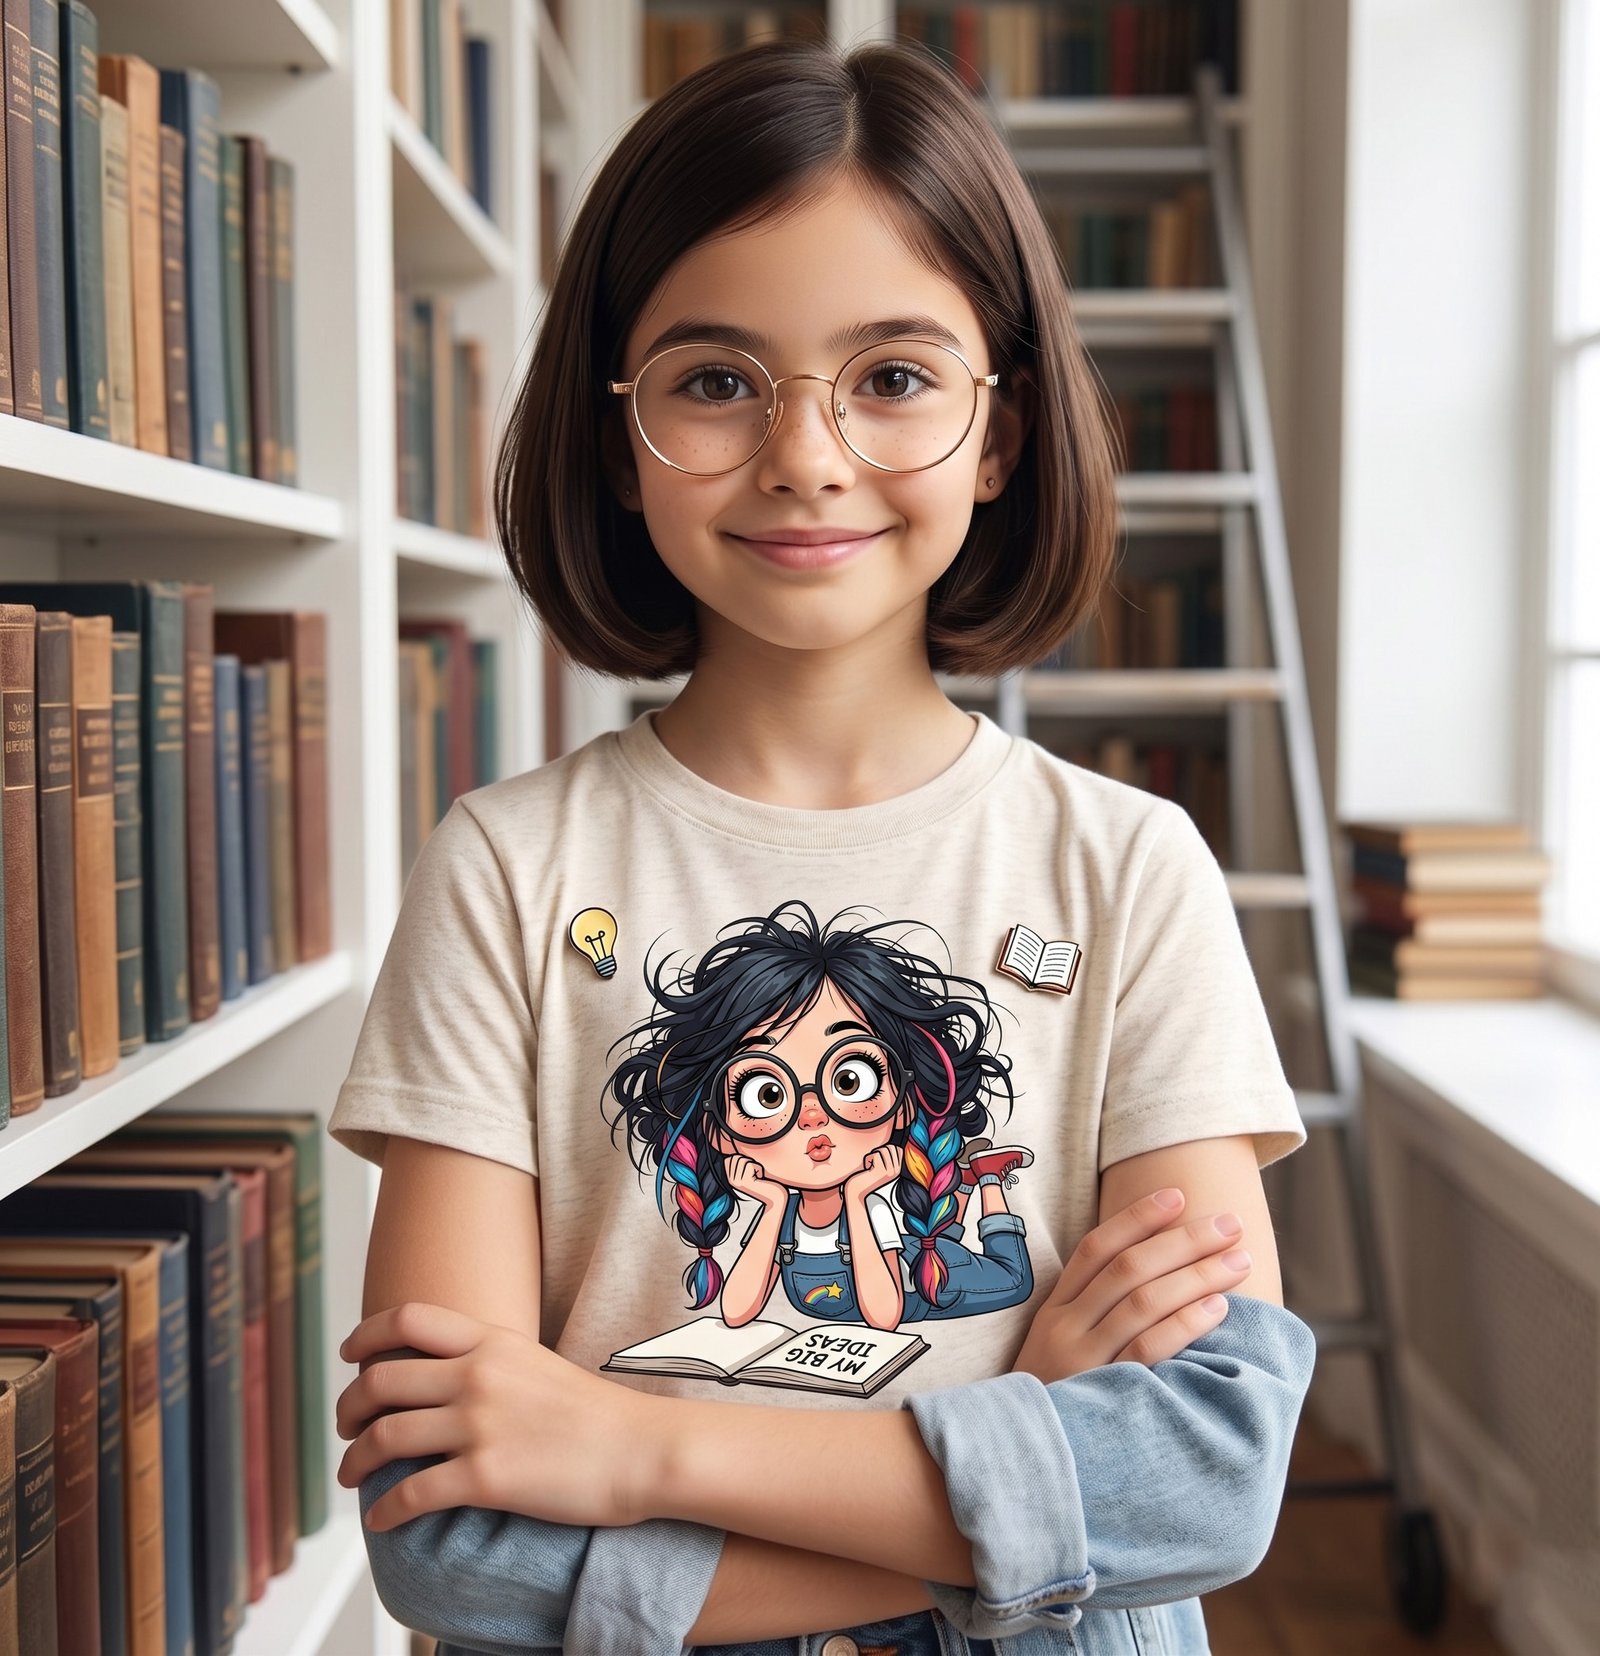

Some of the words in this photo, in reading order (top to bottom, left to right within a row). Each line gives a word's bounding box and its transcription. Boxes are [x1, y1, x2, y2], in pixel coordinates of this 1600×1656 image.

[804, 1333, 878, 1358] IDEAS
[784, 1347, 829, 1368] BIG
[826, 1357, 867, 1376] MY
